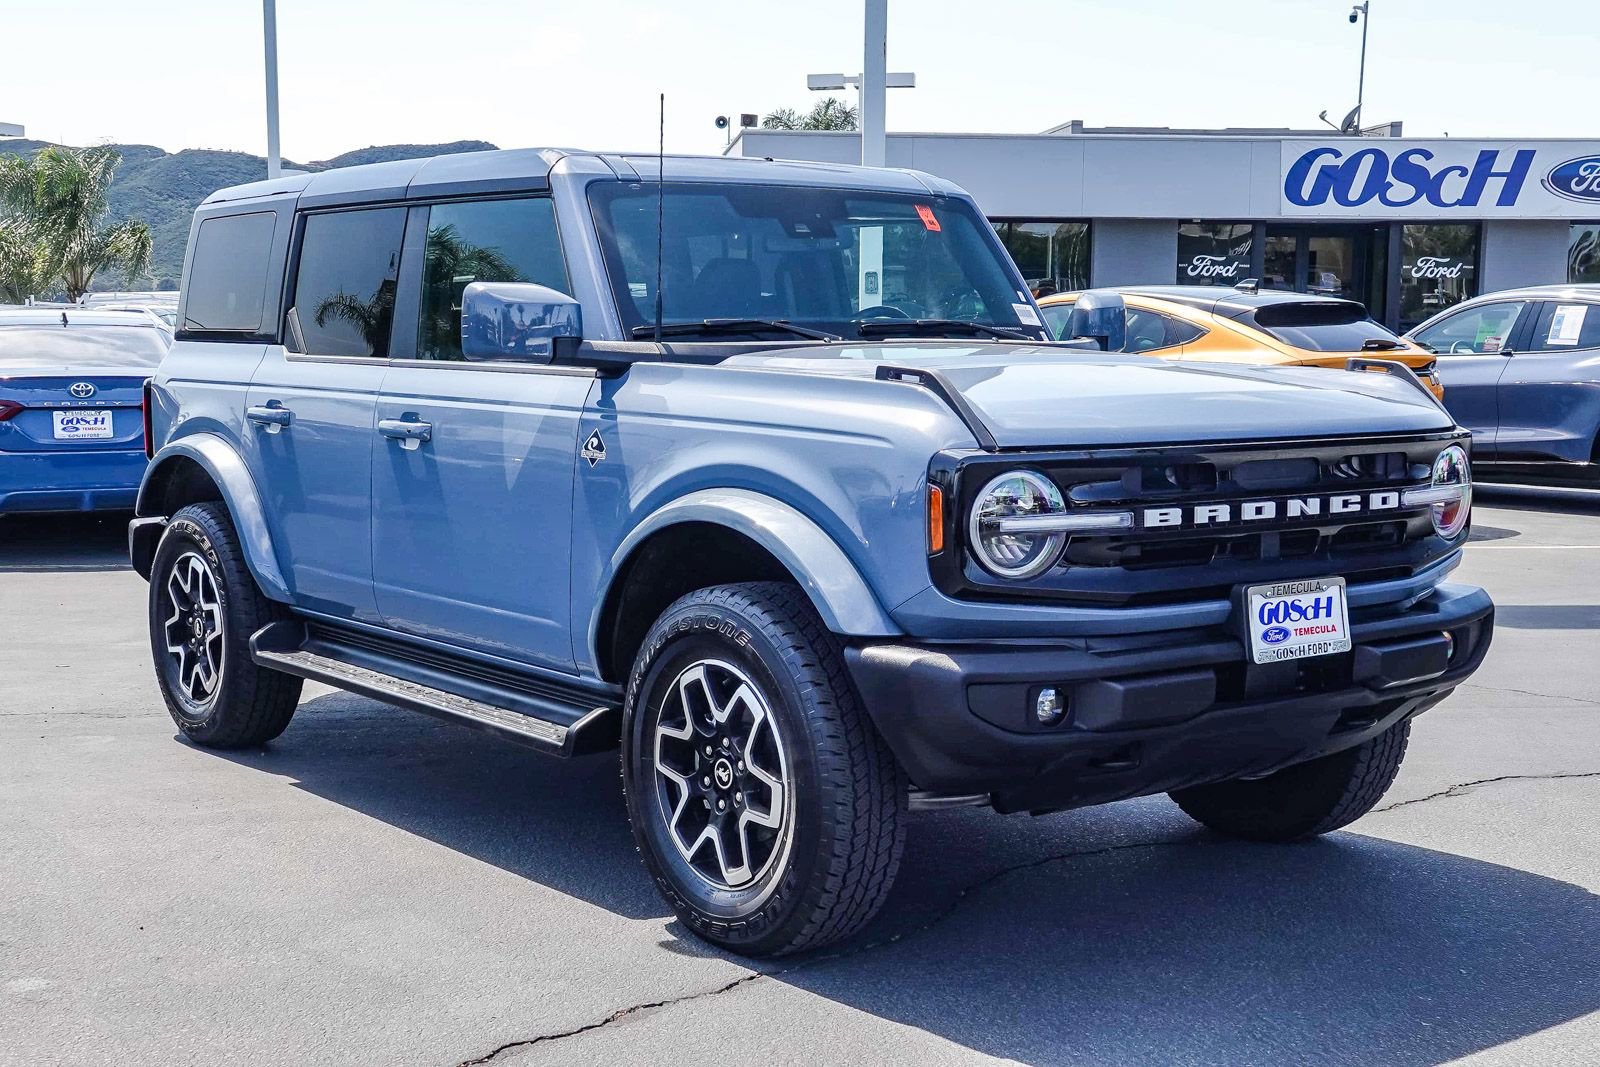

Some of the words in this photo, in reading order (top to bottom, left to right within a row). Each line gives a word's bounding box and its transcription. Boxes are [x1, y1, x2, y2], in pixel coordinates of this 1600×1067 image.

[1570, 162, 1600, 192] Fo
[1187, 255, 1239, 277] Ford
[1411, 256, 1463, 278] Ford
[1143, 491, 1399, 527] BRONCO
[1271, 581, 1322, 596] TEMECULA
[1266, 629, 1285, 644] Ford
[1293, 624, 1337, 637] TEMECULA
[1307, 642, 1328, 656] FORD
